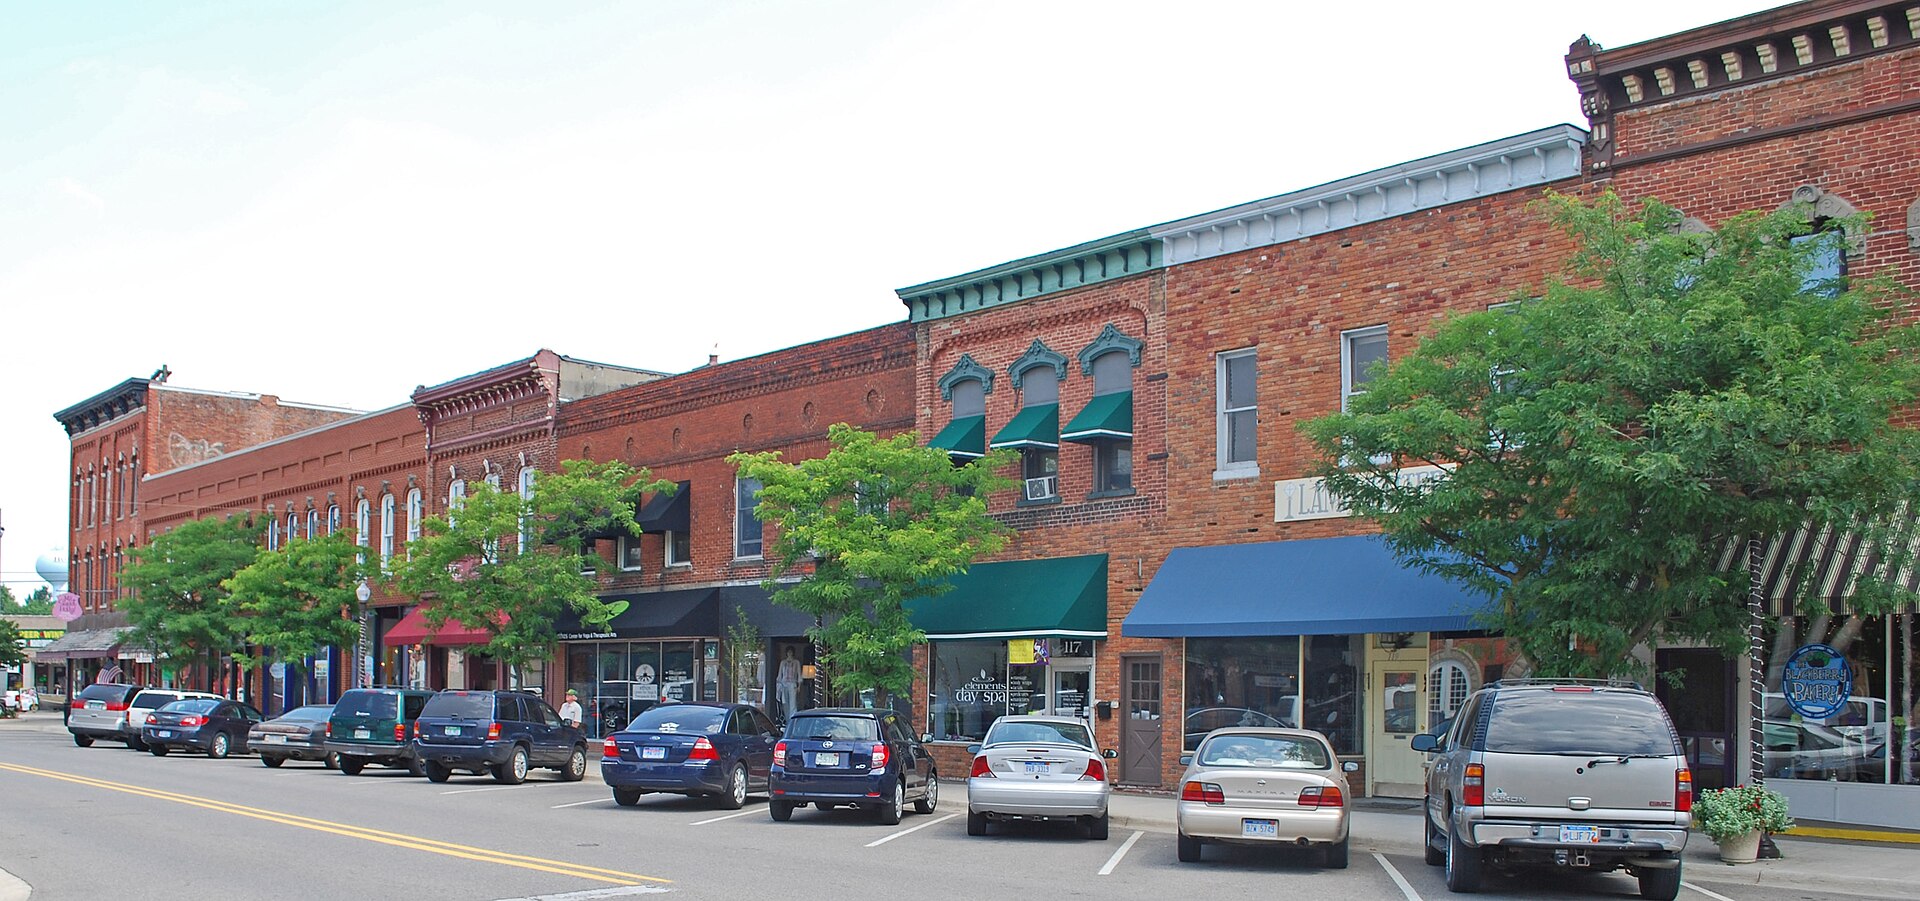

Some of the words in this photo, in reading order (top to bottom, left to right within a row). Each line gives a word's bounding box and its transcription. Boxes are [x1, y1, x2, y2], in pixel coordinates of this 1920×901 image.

[1063, 641, 1082, 653] 117
[1785, 668, 1847, 682] BLACKBERRY
[964, 681, 1007, 690] elements
[956, 688, 979, 704] day
[983, 691, 1006, 705] spa
[1793, 682, 1839, 705] BAKERY
[1487, 795, 1527, 804] YUKON
[1569, 831, 1584, 841] LJF
